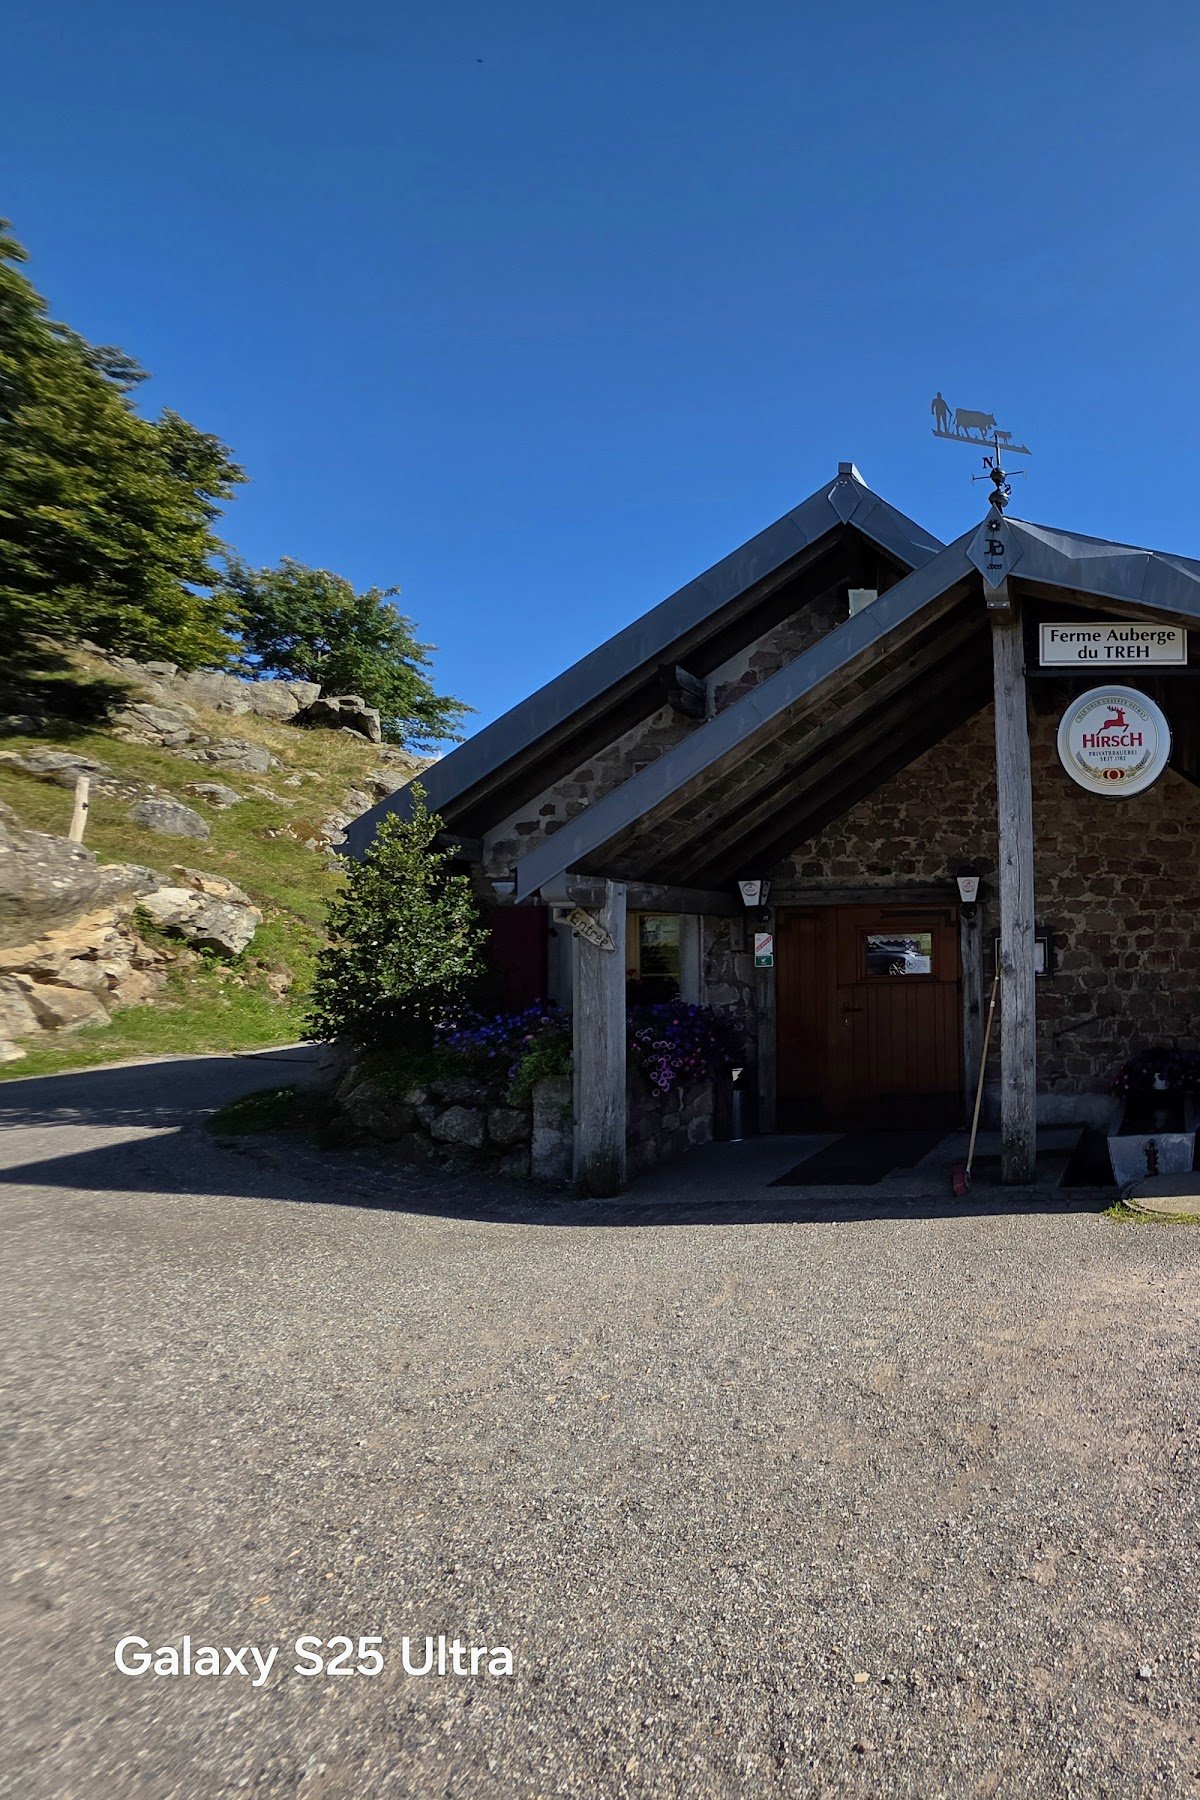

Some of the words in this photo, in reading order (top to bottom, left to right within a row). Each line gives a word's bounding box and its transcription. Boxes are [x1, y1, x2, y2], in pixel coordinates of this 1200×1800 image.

[982, 456, 993, 469] N
[1051, 630, 1101, 642] Ferme
[1106, 628, 1176, 645] Auberge
[1077, 645, 1098, 659] du
[1104, 645, 1149, 659] TREH
[1082, 732, 1143, 748] HIRSCH
